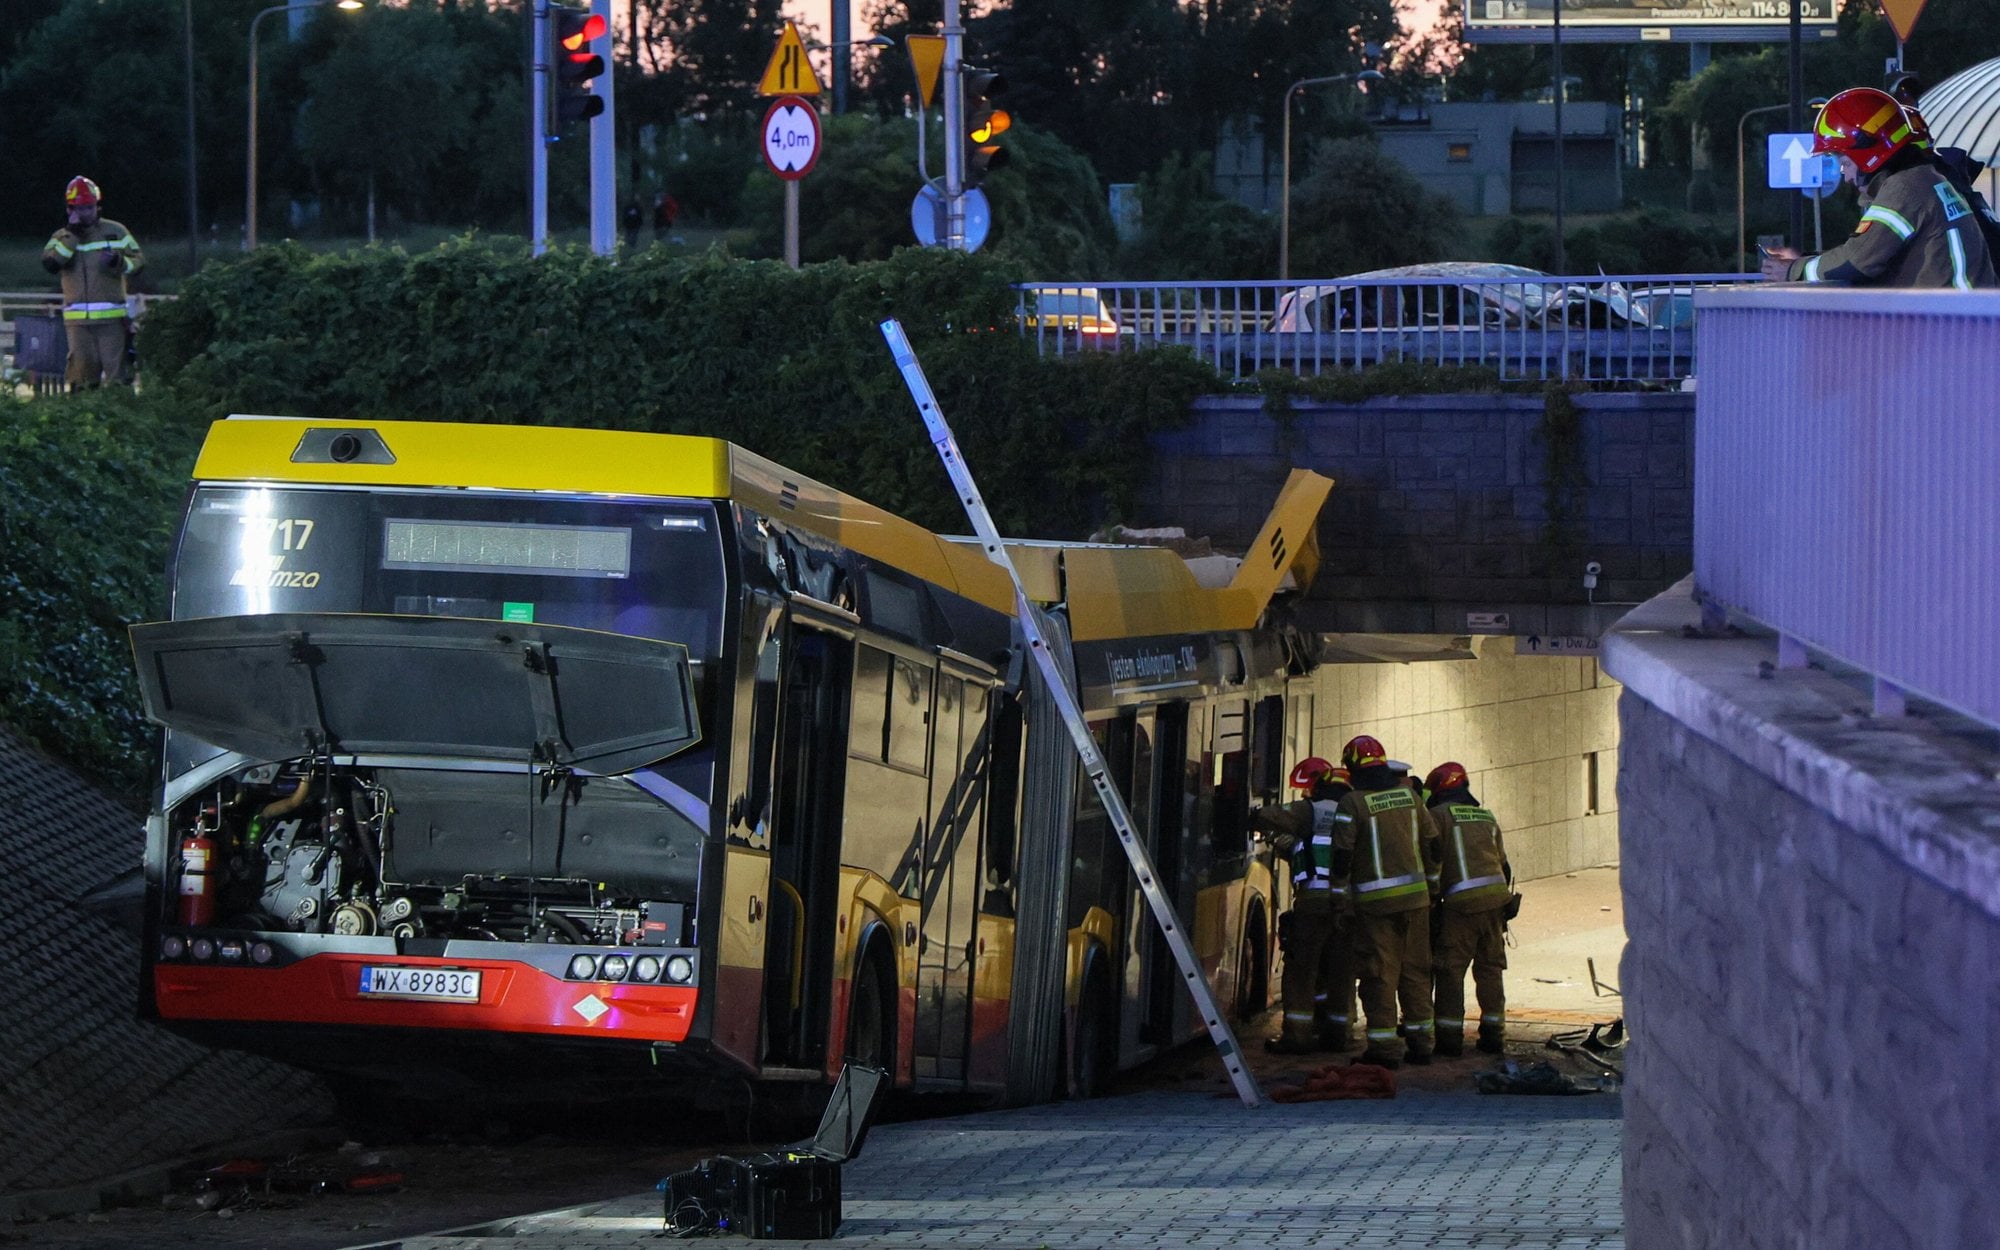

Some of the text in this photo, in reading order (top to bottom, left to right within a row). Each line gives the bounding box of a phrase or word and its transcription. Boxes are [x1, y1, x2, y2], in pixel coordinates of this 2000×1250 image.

[1752, 2, 1776, 17] 114
[1777, 2, 1811, 17] 80
[771, 126, 810, 150] 4,0m
[375, 970, 402, 991] WX
